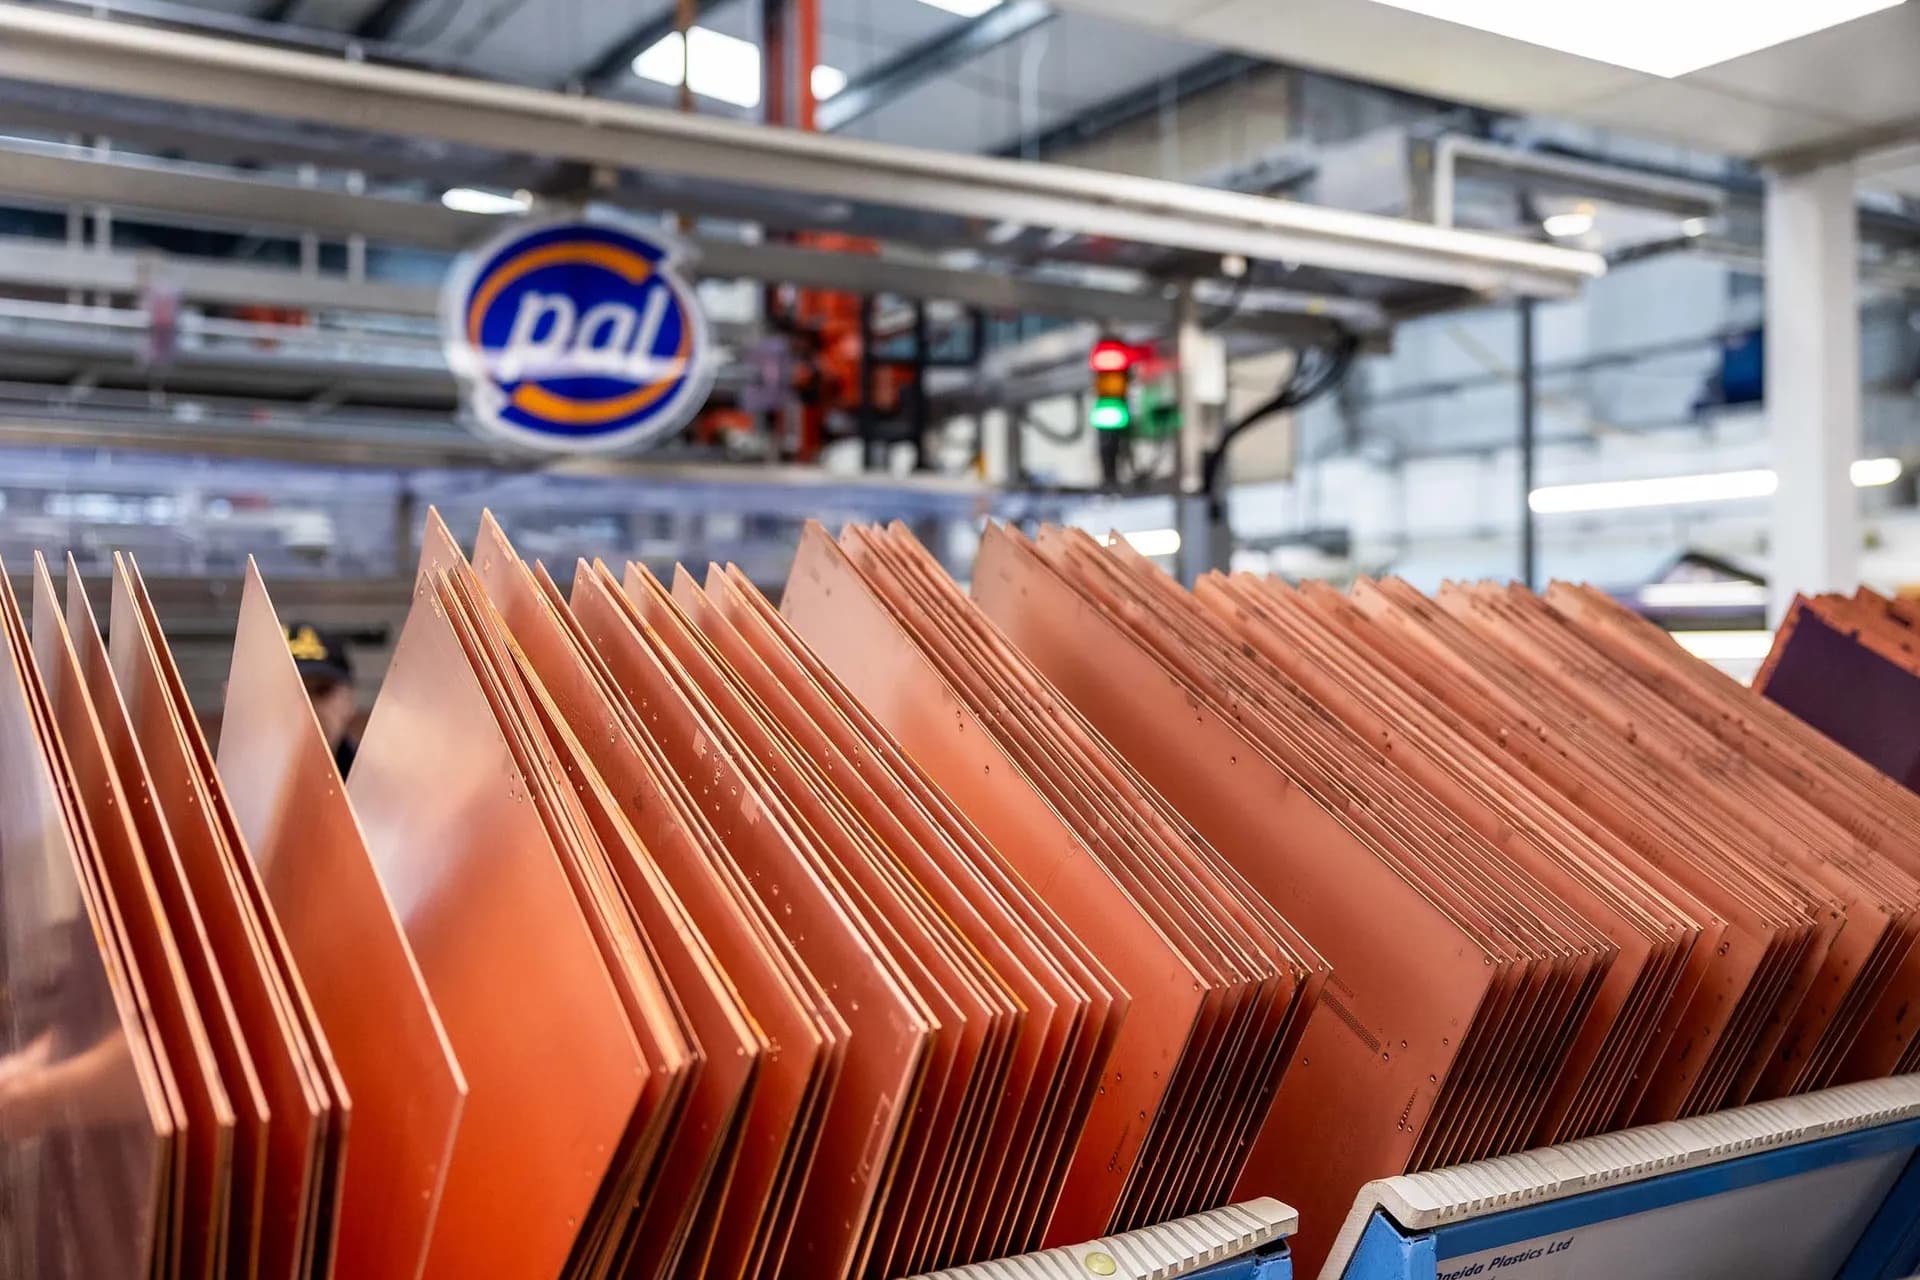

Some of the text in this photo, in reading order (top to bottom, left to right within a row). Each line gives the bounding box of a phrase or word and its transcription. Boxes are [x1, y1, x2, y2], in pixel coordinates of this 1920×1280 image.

[502, 284, 671, 381] pal
[1488, 1247, 1544, 1271] Plastics
[1547, 1237, 1575, 1255] Ltd
